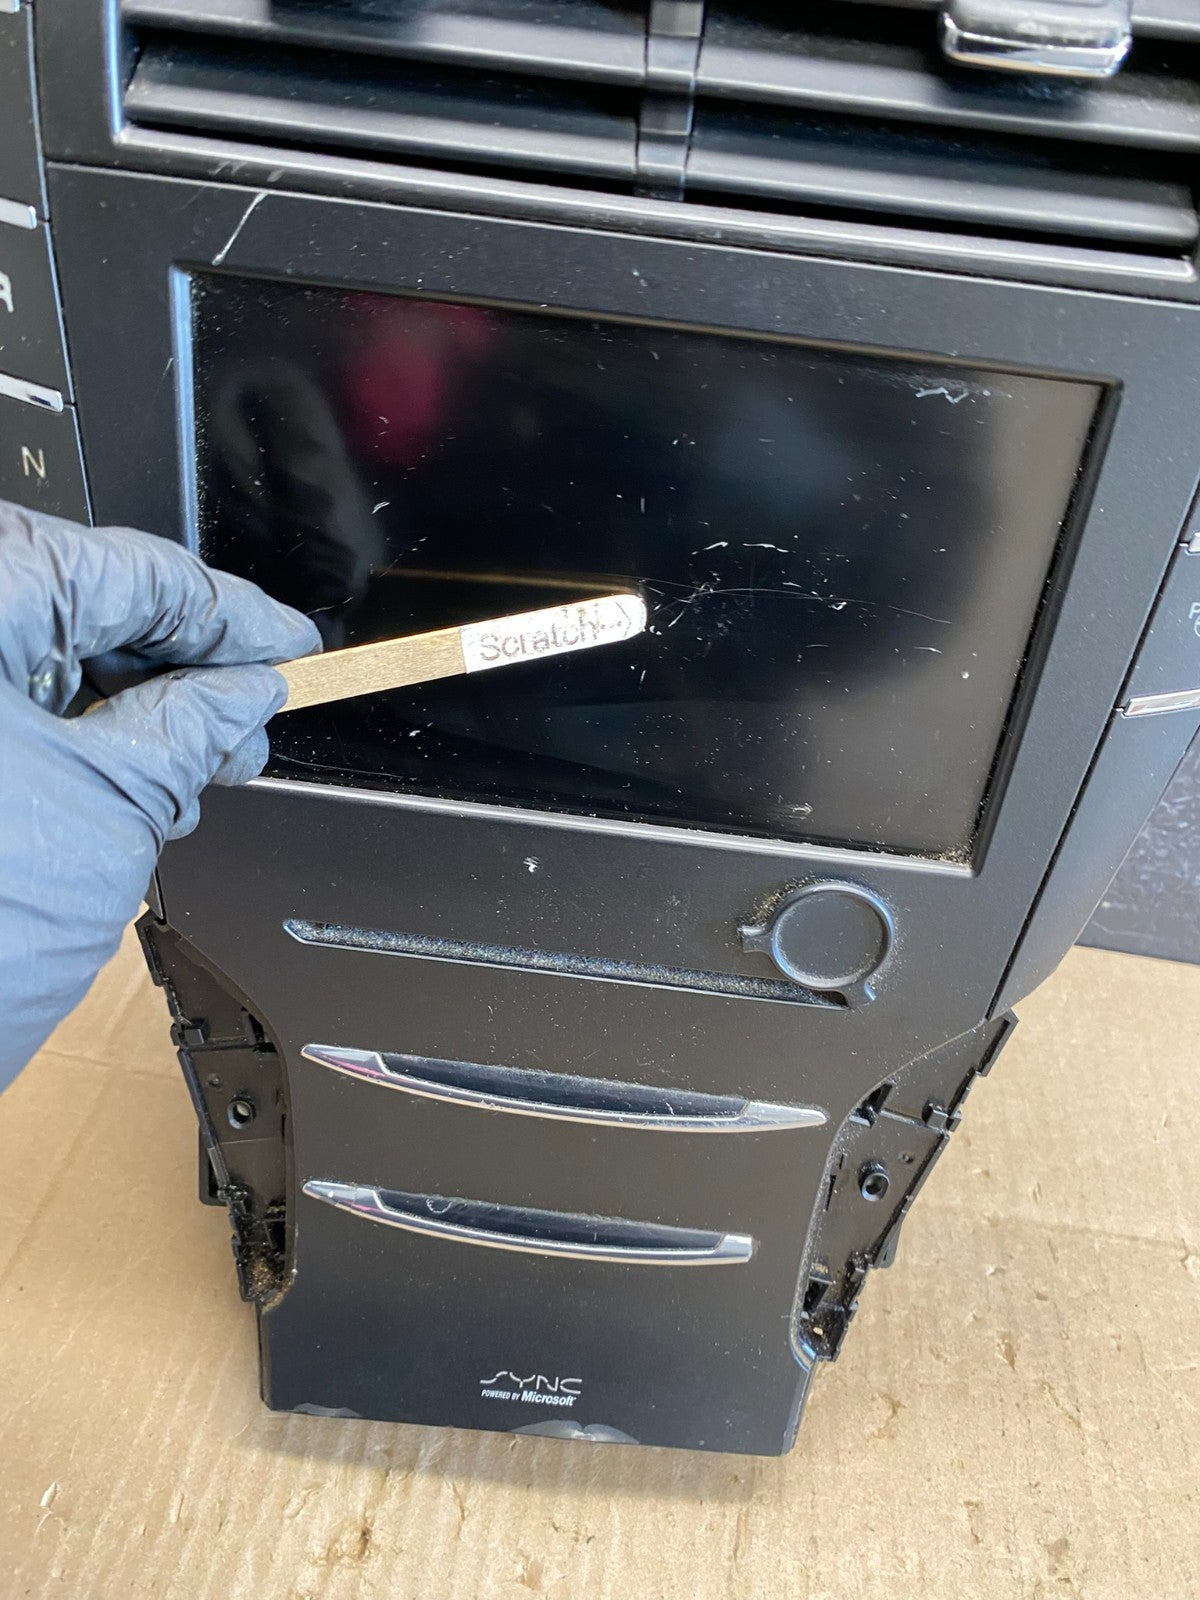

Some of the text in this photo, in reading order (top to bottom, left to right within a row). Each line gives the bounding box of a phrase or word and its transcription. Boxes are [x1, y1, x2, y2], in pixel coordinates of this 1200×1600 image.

[21, 446, 46, 479] N
[480, 1371, 582, 1394] SYNC
[481, 1389, 510, 1400] POWERED
[511, 1392, 520, 1401] BY
